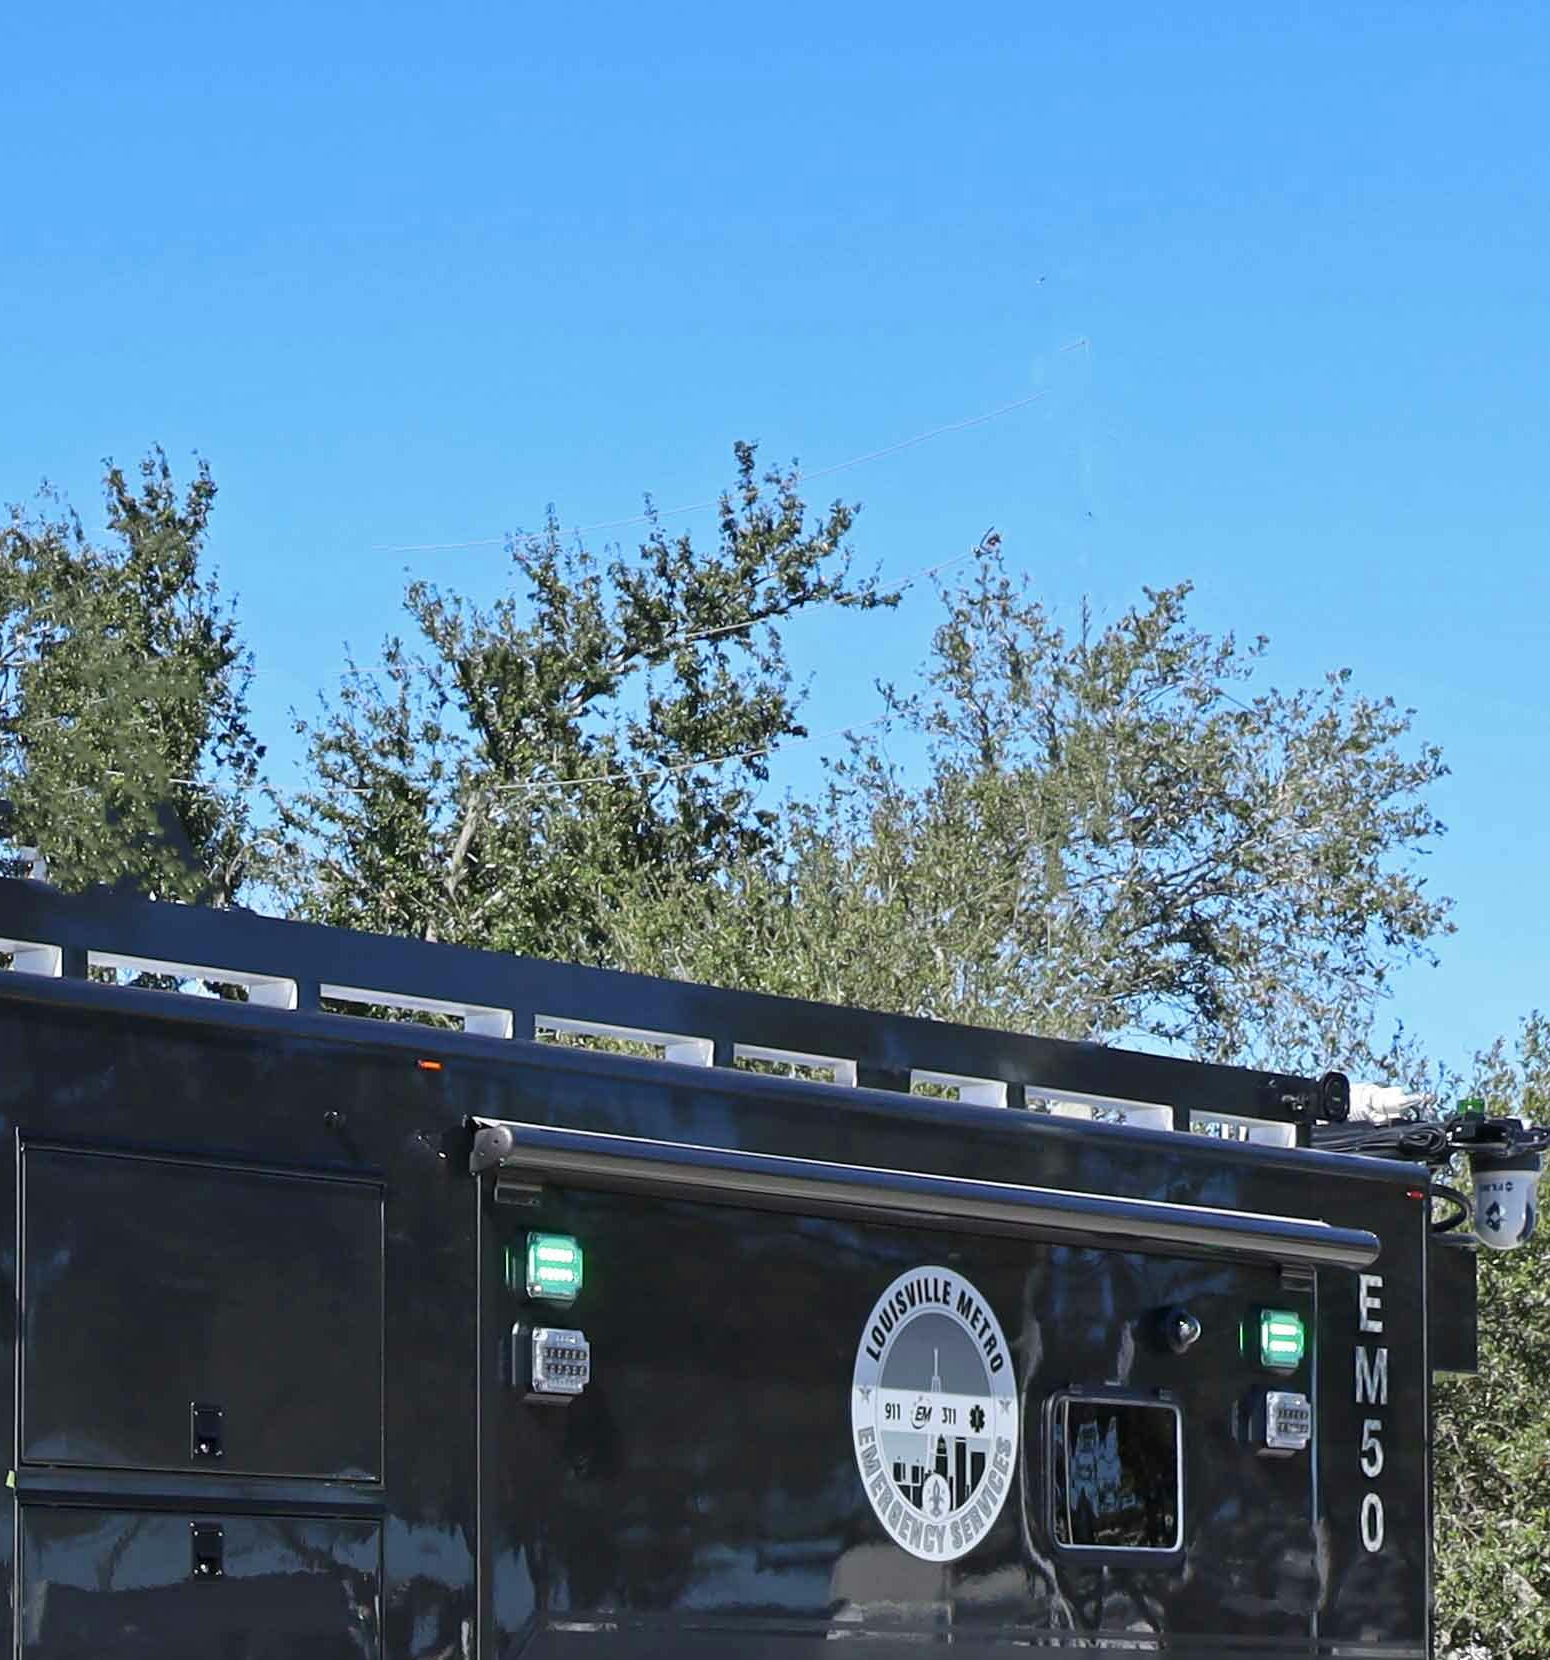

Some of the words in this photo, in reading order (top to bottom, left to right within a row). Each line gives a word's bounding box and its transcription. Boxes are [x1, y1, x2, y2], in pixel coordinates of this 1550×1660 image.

[866, 1277, 952, 1363] LOUISVILLE
[956, 1289, 1005, 1375] METRO
[885, 1402, 901, 1421] 911
[941, 1407, 957, 1425] 311
[1355, 1273, 1388, 1553] EM50
[857, 1425, 948, 1554] EMERGENCY
[951, 1435, 1013, 1550] SERVICES
